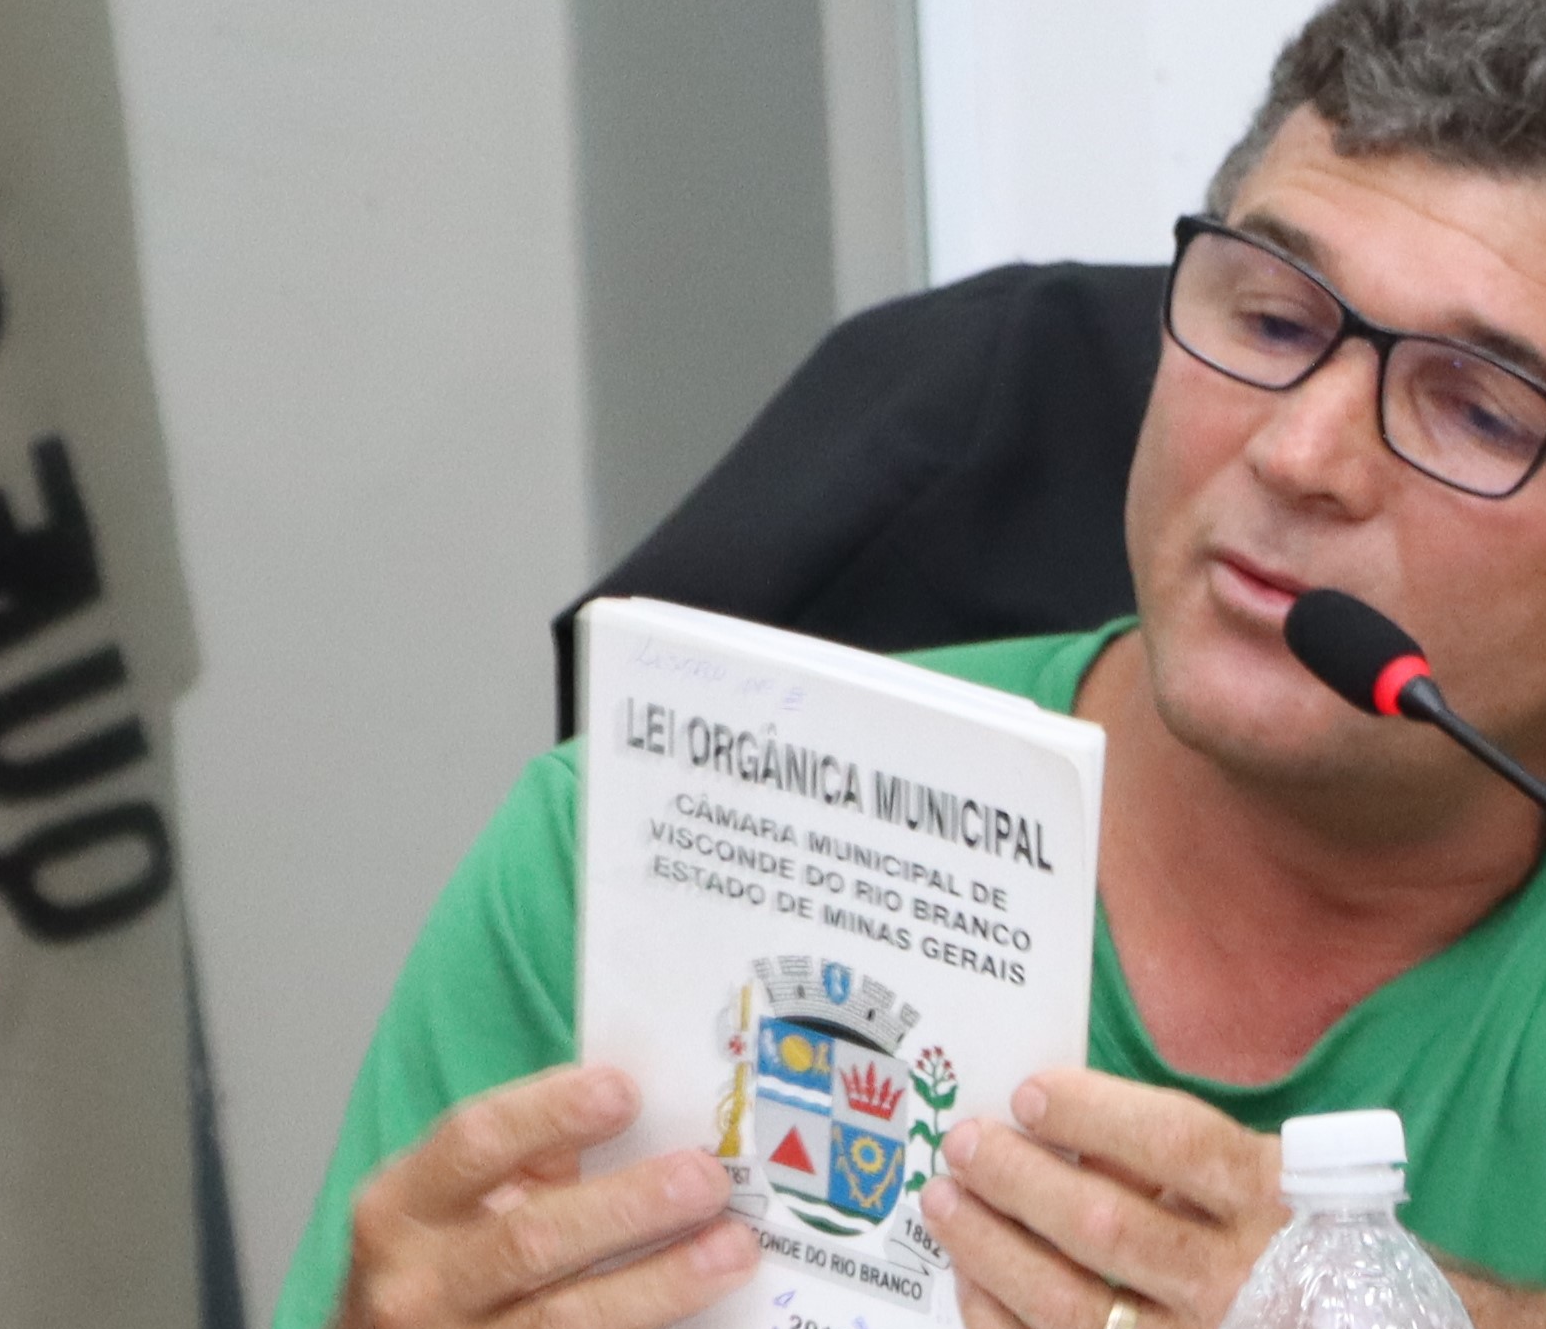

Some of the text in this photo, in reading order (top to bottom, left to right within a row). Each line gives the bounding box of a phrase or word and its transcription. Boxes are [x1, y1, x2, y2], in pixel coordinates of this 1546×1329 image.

[627, 697, 1054, 873] LEI ORGÂNICA MUNICIPAL
[650, 818, 1032, 952] VISCONDE DO RIO BRANCO
[675, 793, 1008, 912] CÂMARA MUNICIPAL DE
[654, 855, 1026, 986] ESTADO DE MINAS GERAIS
[806, 1247, 827, 1267] DO
[831, 1253, 855, 1278] RIO
[859, 1263, 923, 1301] BRANCO
